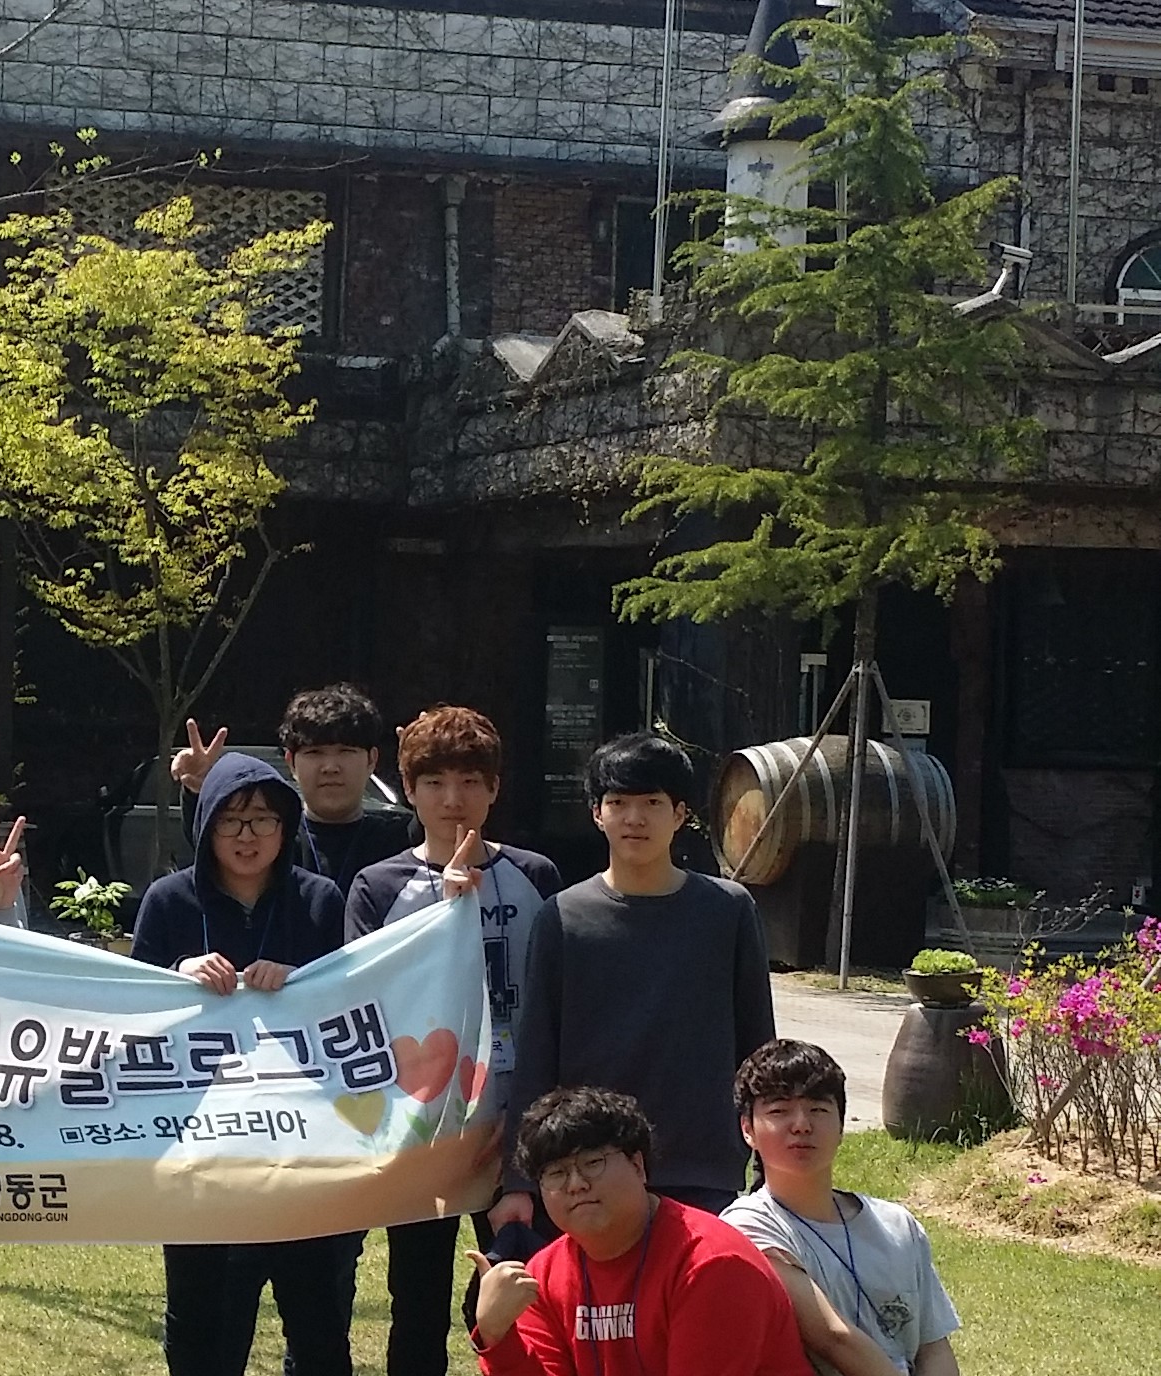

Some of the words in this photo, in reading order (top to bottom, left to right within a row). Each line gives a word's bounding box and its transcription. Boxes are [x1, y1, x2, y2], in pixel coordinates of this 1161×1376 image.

[480, 904, 518, 926] MP
[85, 1122, 147, 1145] 장소:
[152, 1109, 307, 1143] 와인코리아
